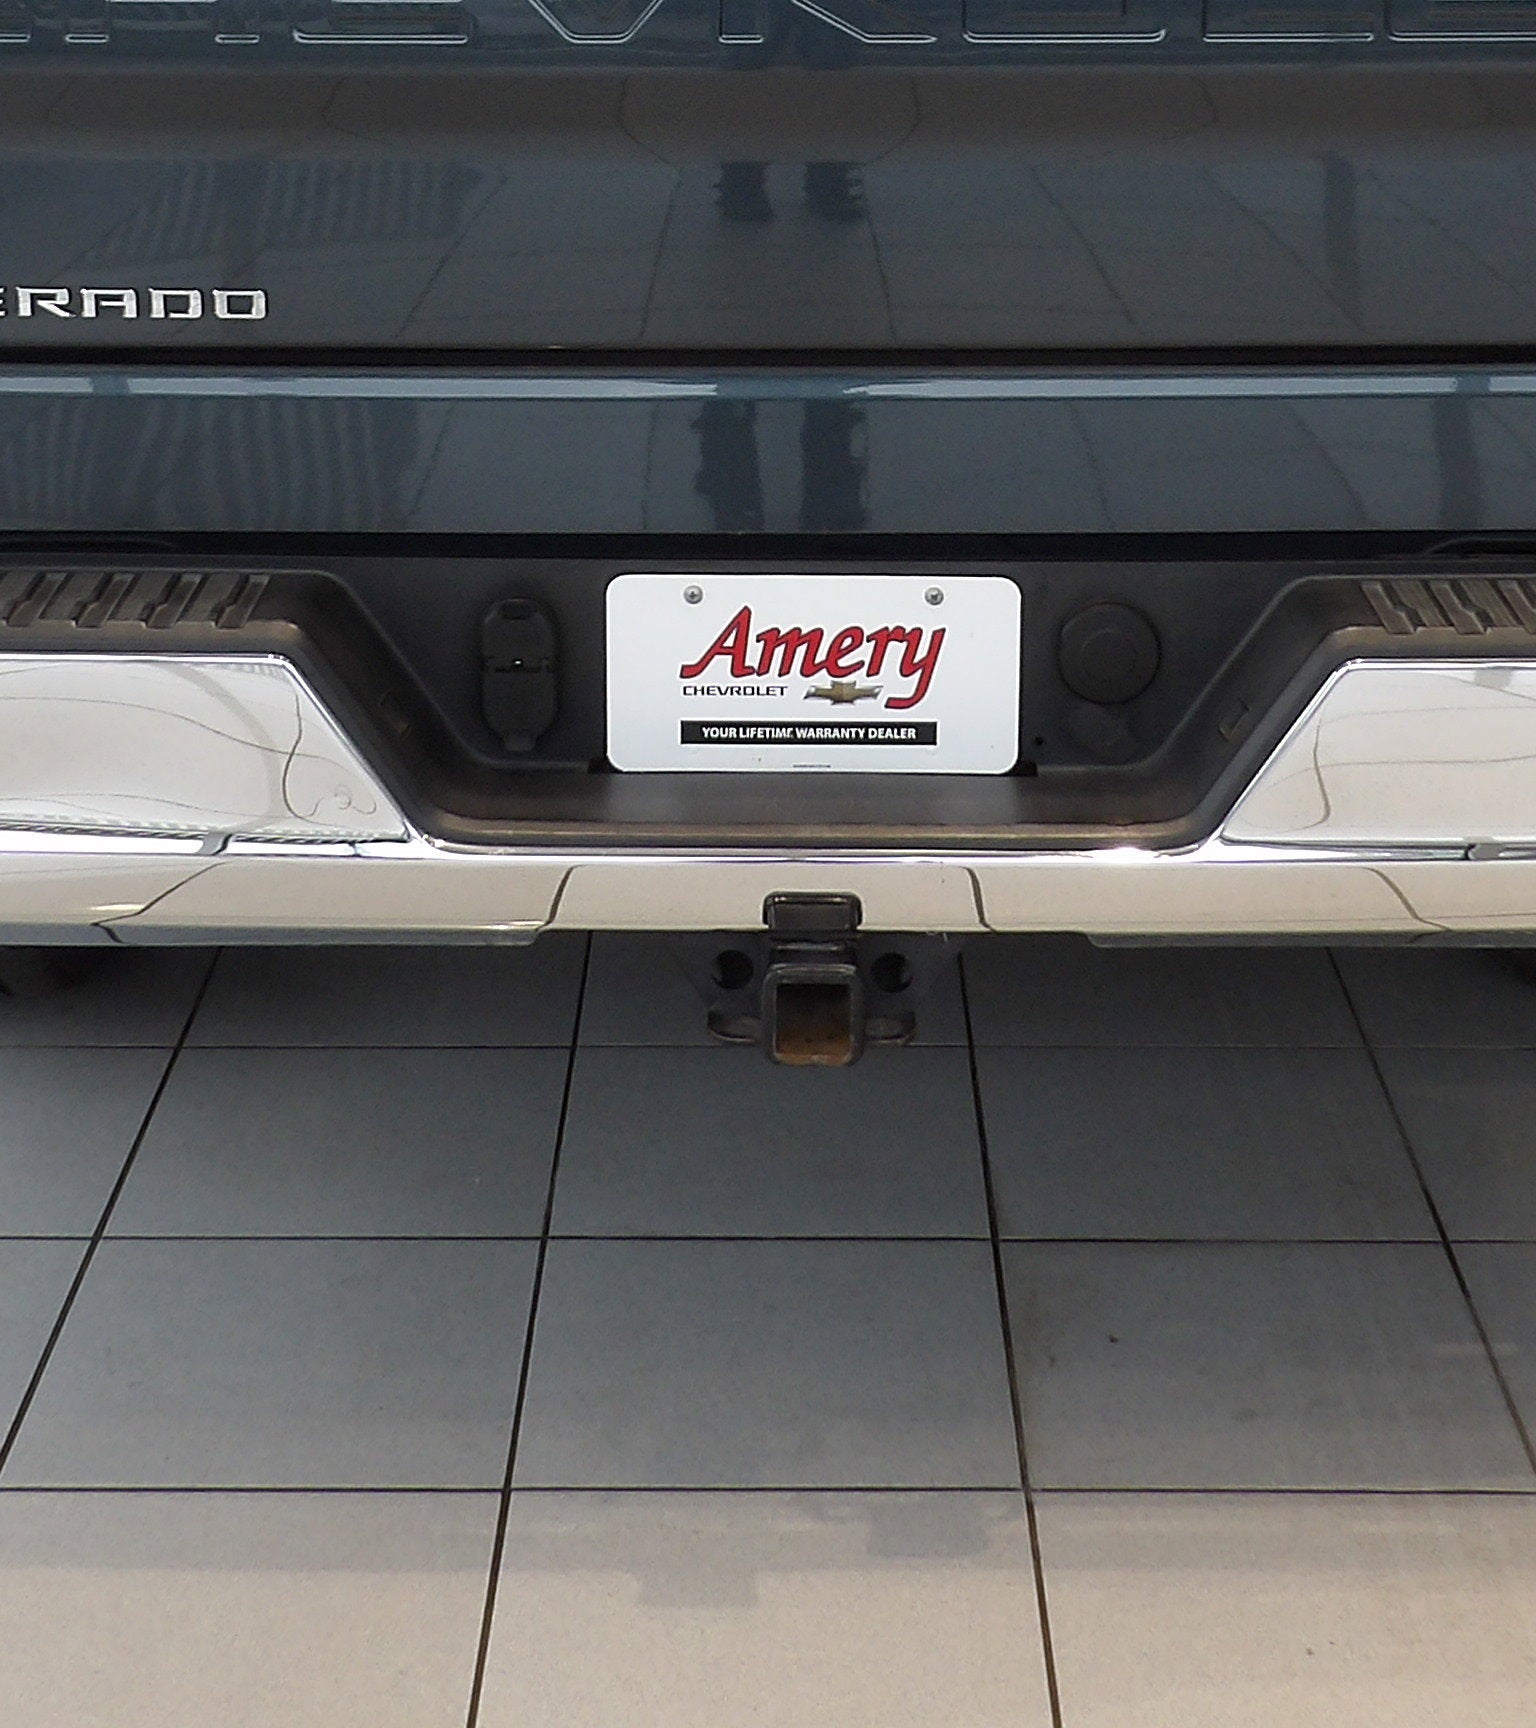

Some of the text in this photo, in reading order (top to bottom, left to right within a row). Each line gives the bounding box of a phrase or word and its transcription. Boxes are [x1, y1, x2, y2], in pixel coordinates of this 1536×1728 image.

[680, 605, 947, 710] Amery
[682, 684, 789, 697] CHEVROLET
[702, 727, 917, 739] YOUR LIFETIME WARRANTY DEALER
